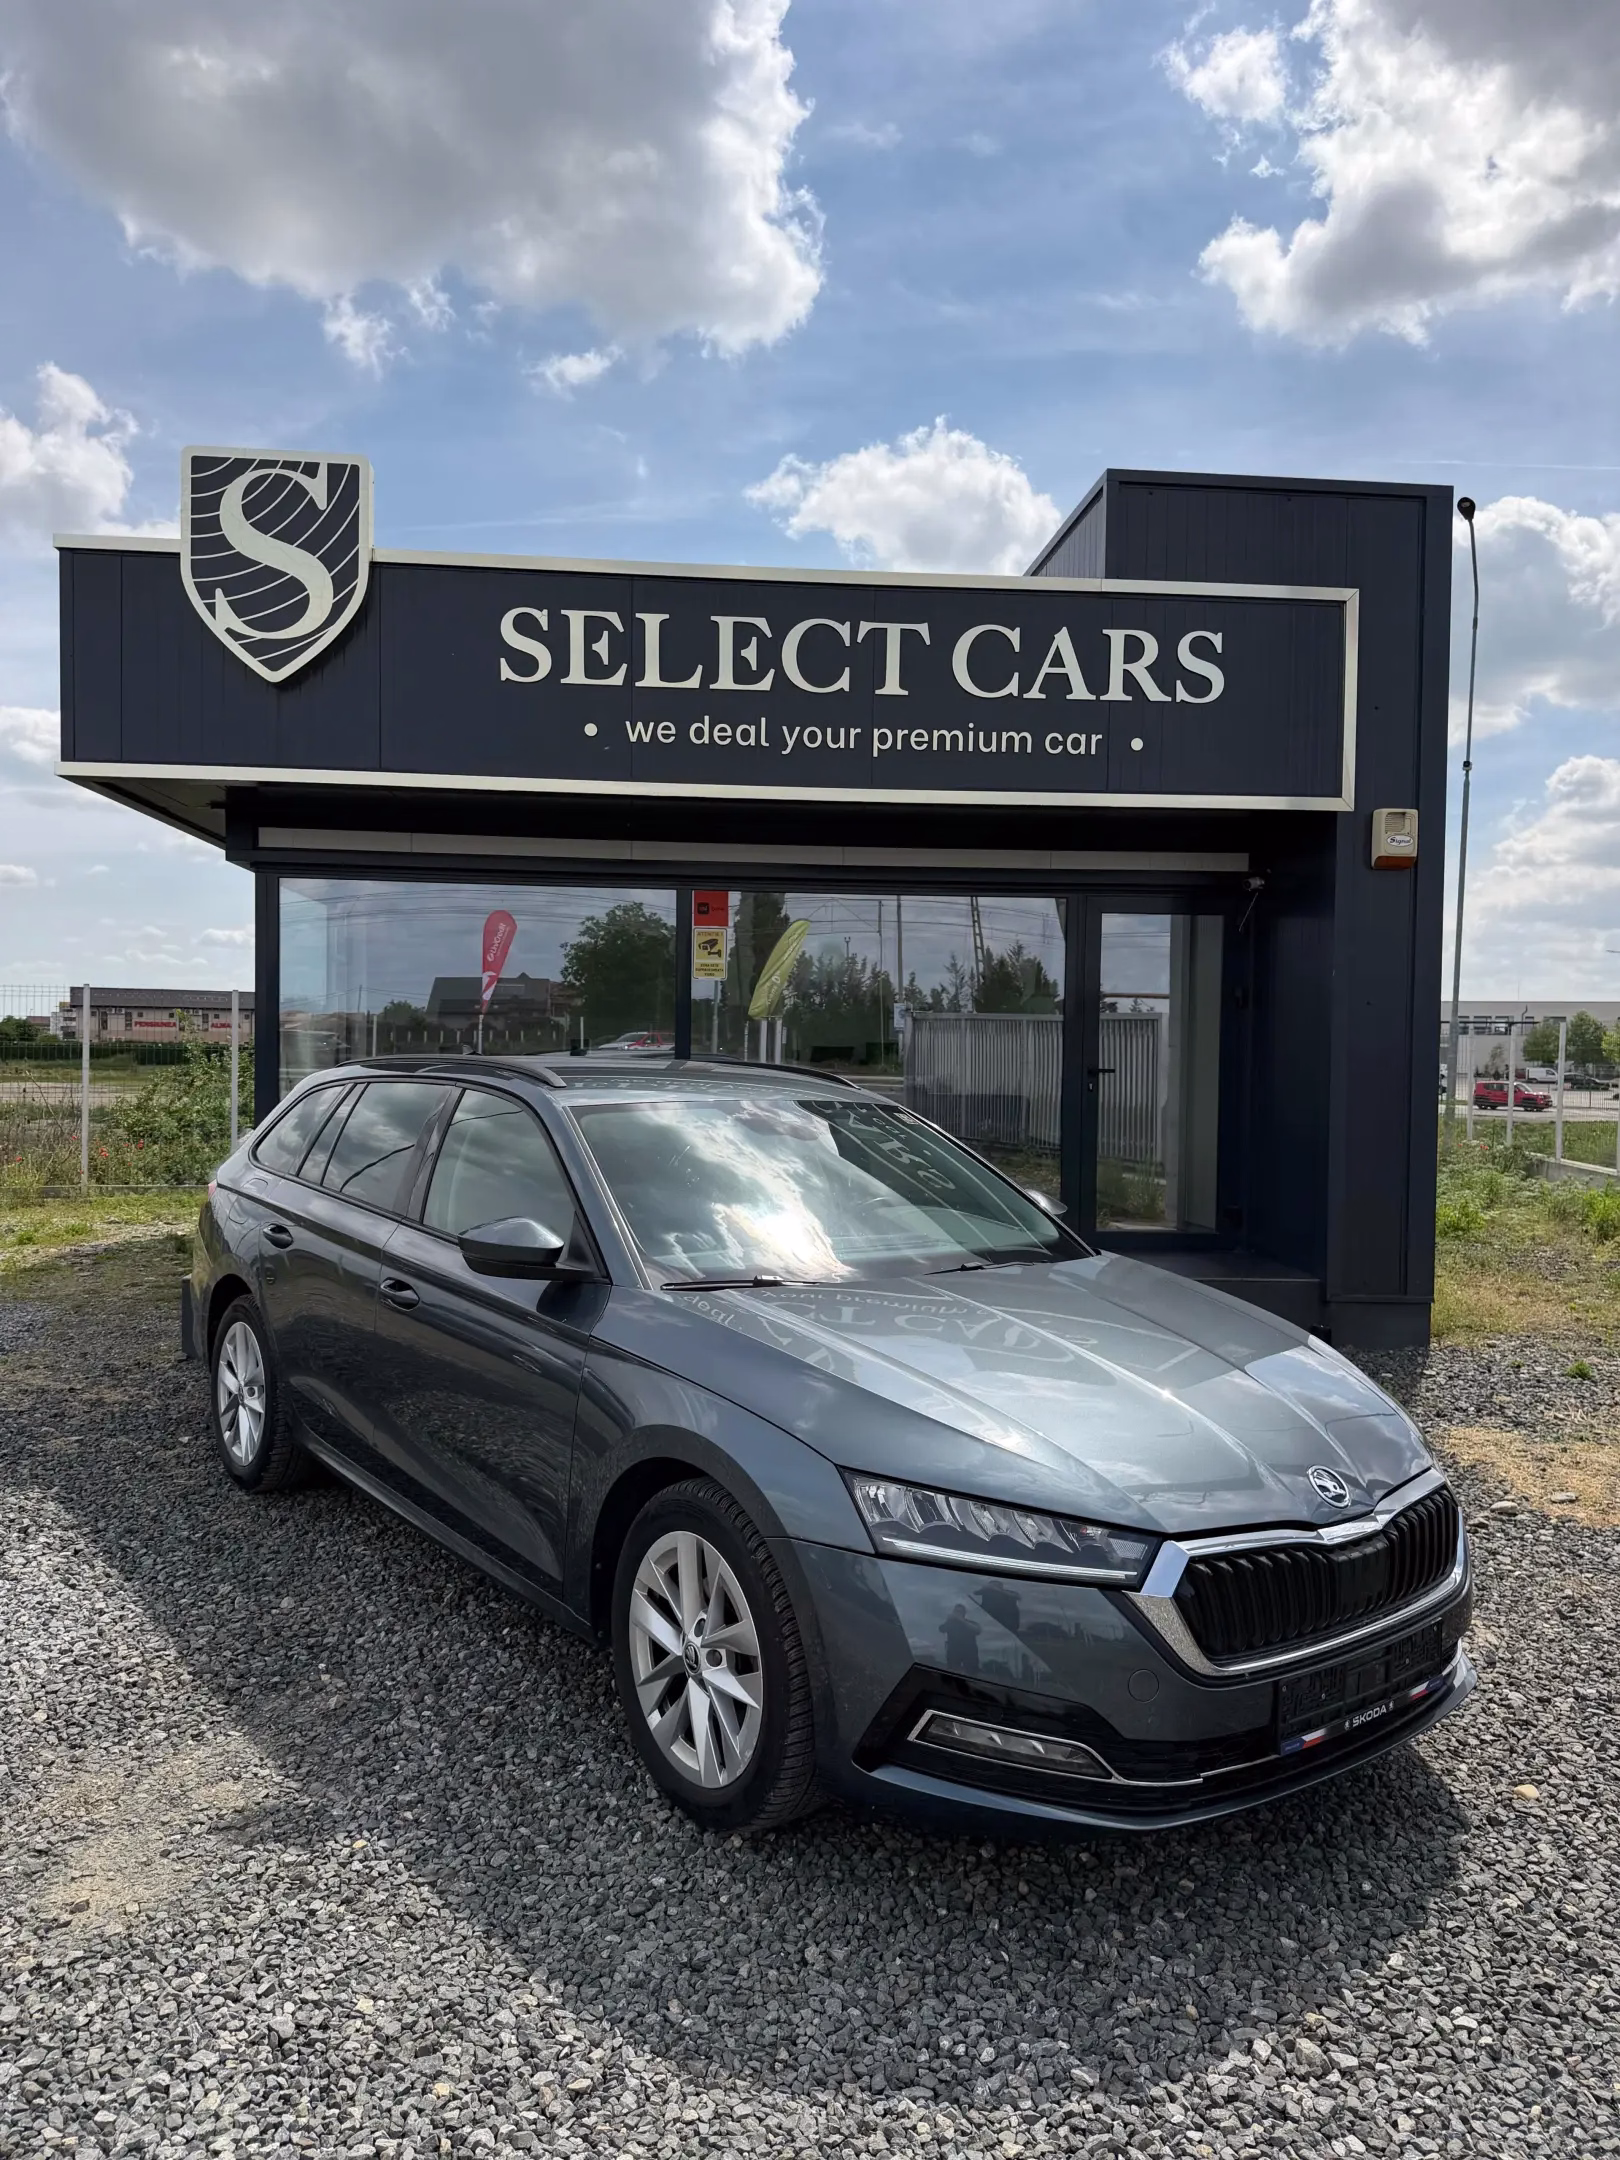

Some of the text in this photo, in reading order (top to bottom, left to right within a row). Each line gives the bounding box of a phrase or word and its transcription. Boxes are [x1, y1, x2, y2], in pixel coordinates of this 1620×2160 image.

[219, 461, 334, 639] S
[500, 606, 1225, 703] SELECT CARS
[625, 715, 1102, 758] we deal your premium car
